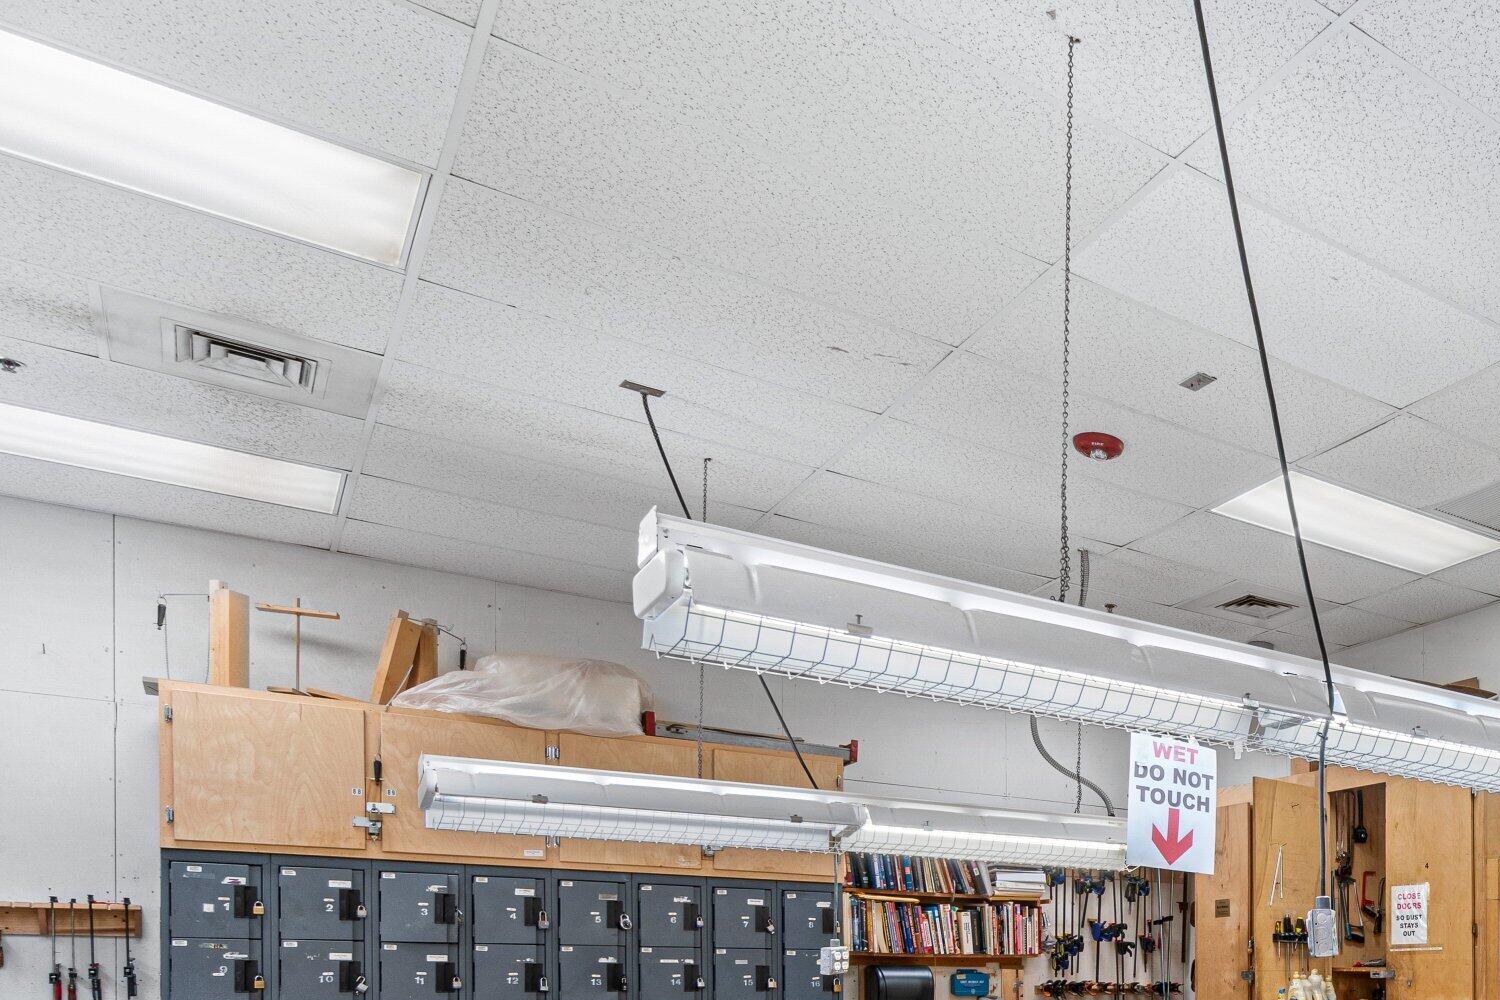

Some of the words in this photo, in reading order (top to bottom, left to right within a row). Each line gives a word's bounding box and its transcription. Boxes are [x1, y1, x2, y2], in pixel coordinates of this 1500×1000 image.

[1152, 740, 1199, 766] WET
[1134, 761, 1165, 781] DO
[1172, 768, 1214, 791] NOT
[1135, 785, 1211, 813] TOUCH
[1424, 862, 1430, 870] 4
[1397, 892, 1421, 900] CLOSE
[224, 903, 230, 911] 1
[326, 904, 334, 912] 2
[1396, 902, 1422, 910] DOORS
[420, 908, 428, 916] 3
[219, 965, 228, 974] 9
[318, 975, 334, 983] 10
[414, 976, 425, 984] 11
[590, 978, 601, 986] 13
